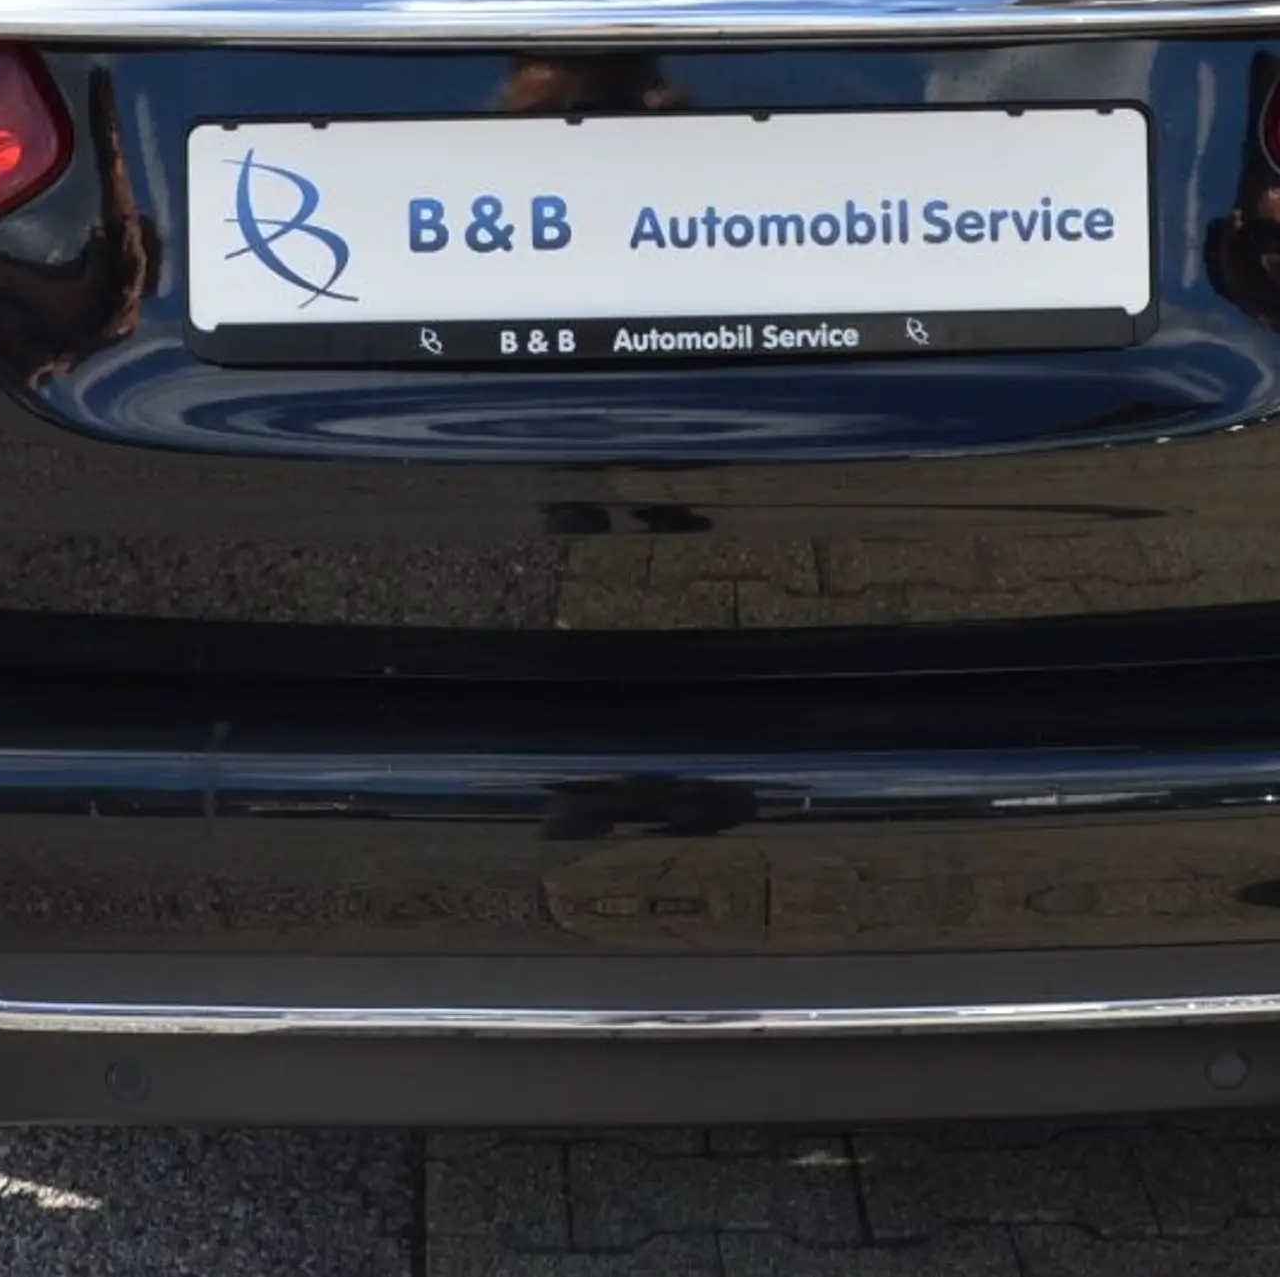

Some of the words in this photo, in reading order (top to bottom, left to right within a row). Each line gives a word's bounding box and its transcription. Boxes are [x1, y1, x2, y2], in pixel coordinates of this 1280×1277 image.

[629, 198, 910, 250] Automobil
[922, 196, 1115, 244] Service
[613, 324, 753, 352] Automobil
[762, 321, 860, 349] Service
